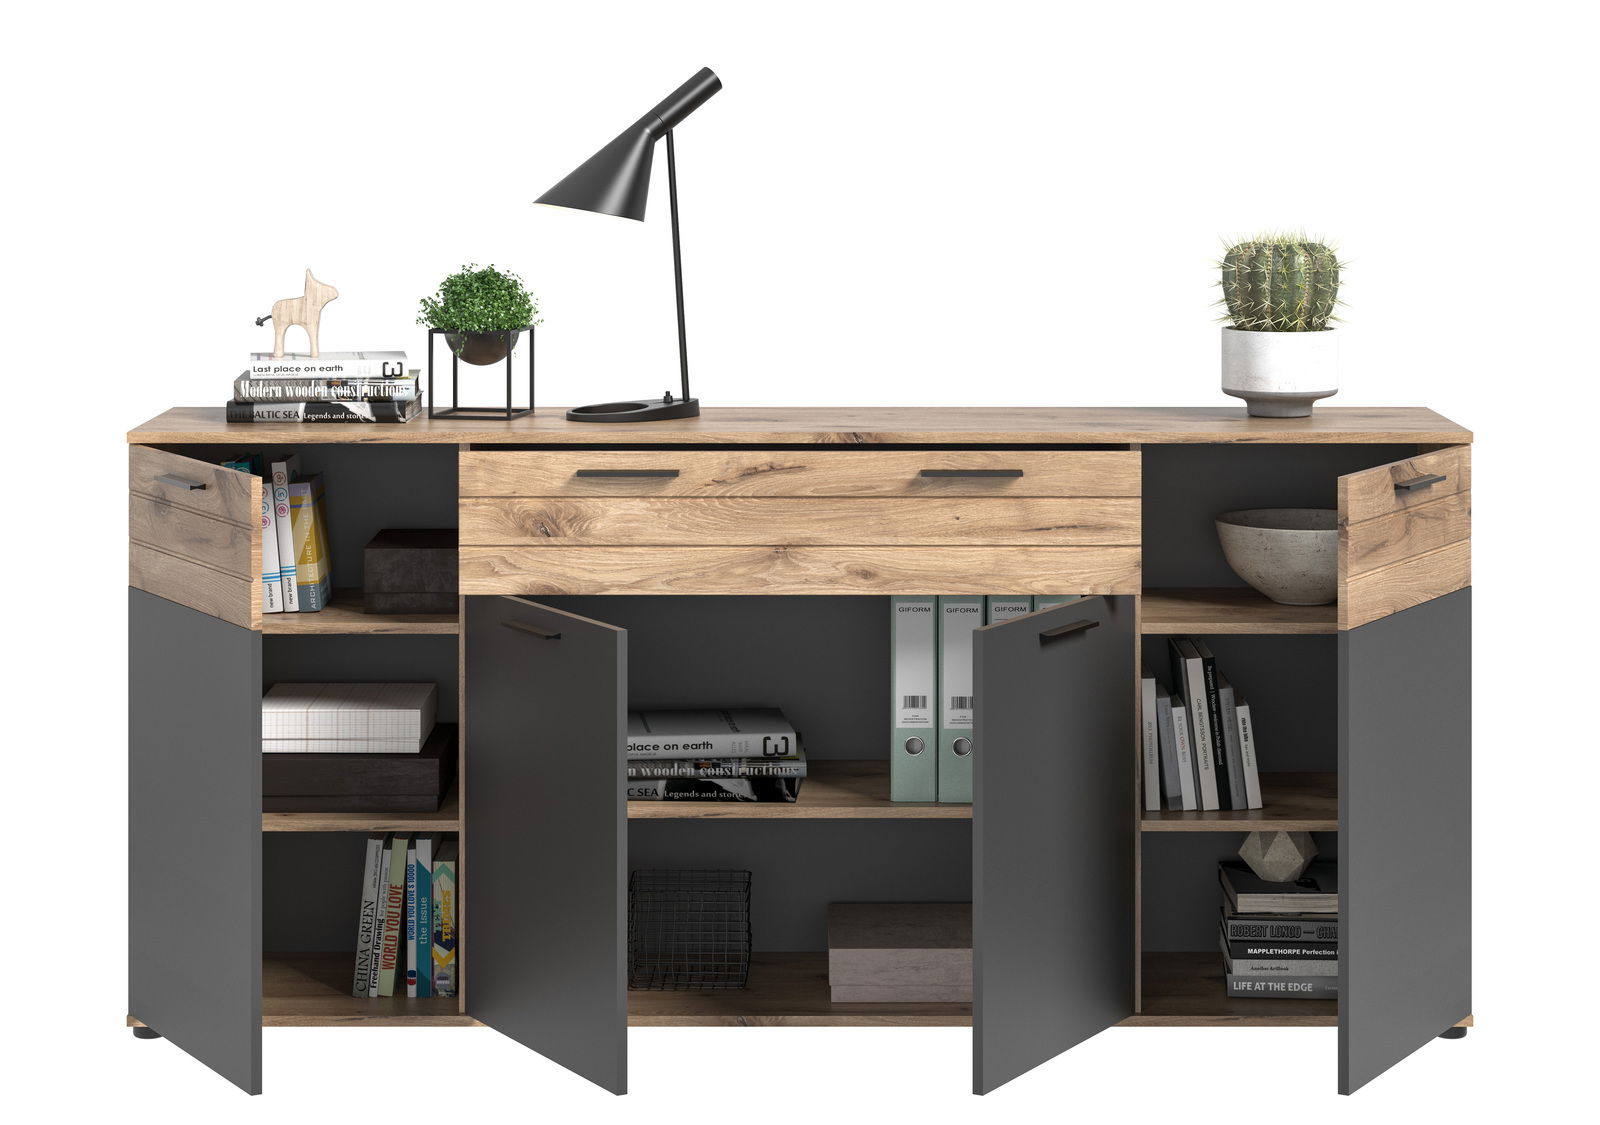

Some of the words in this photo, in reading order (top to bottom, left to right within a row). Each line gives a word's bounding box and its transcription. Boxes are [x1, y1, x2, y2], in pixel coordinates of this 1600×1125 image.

[253, 365, 271, 373] Last
[273, 365, 301, 374] place
[319, 364, 343, 373] earth
[240, 380, 282, 398] Modern
[285, 380, 327, 398] wooden
[331, 379, 408, 398] constructions
[249, 410, 281, 419] BALTIC
[282, 410, 300, 419] SEA
[303, 412, 331, 422] Legends
[682, 741, 713, 750] earth
[640, 762, 696, 777] wooden
[699, 762, 799, 777] constructions
[637, 788, 659, 797] SEA
[664, 790, 700, 800] Legends
[388, 884, 403, 909] LOVE
[360, 900, 375, 944] GREEN
[387, 911, 400, 932] YOU
[375, 918, 385, 950] Drawing
[419, 927, 428, 944] the
[1230, 924, 1268, 938] ROBERT
[1270, 925, 1301, 938] LONGO
[382, 935, 398, 970] WORLD
[355, 948, 371, 992] CHINA
[372, 952, 380, 988] Freehand
[1233, 981, 1252, 990] LIFE
[1254, 982, 1266, 991] AT
[1268, 982, 1286, 992] THE
[1288, 982, 1313, 992] EDGE
